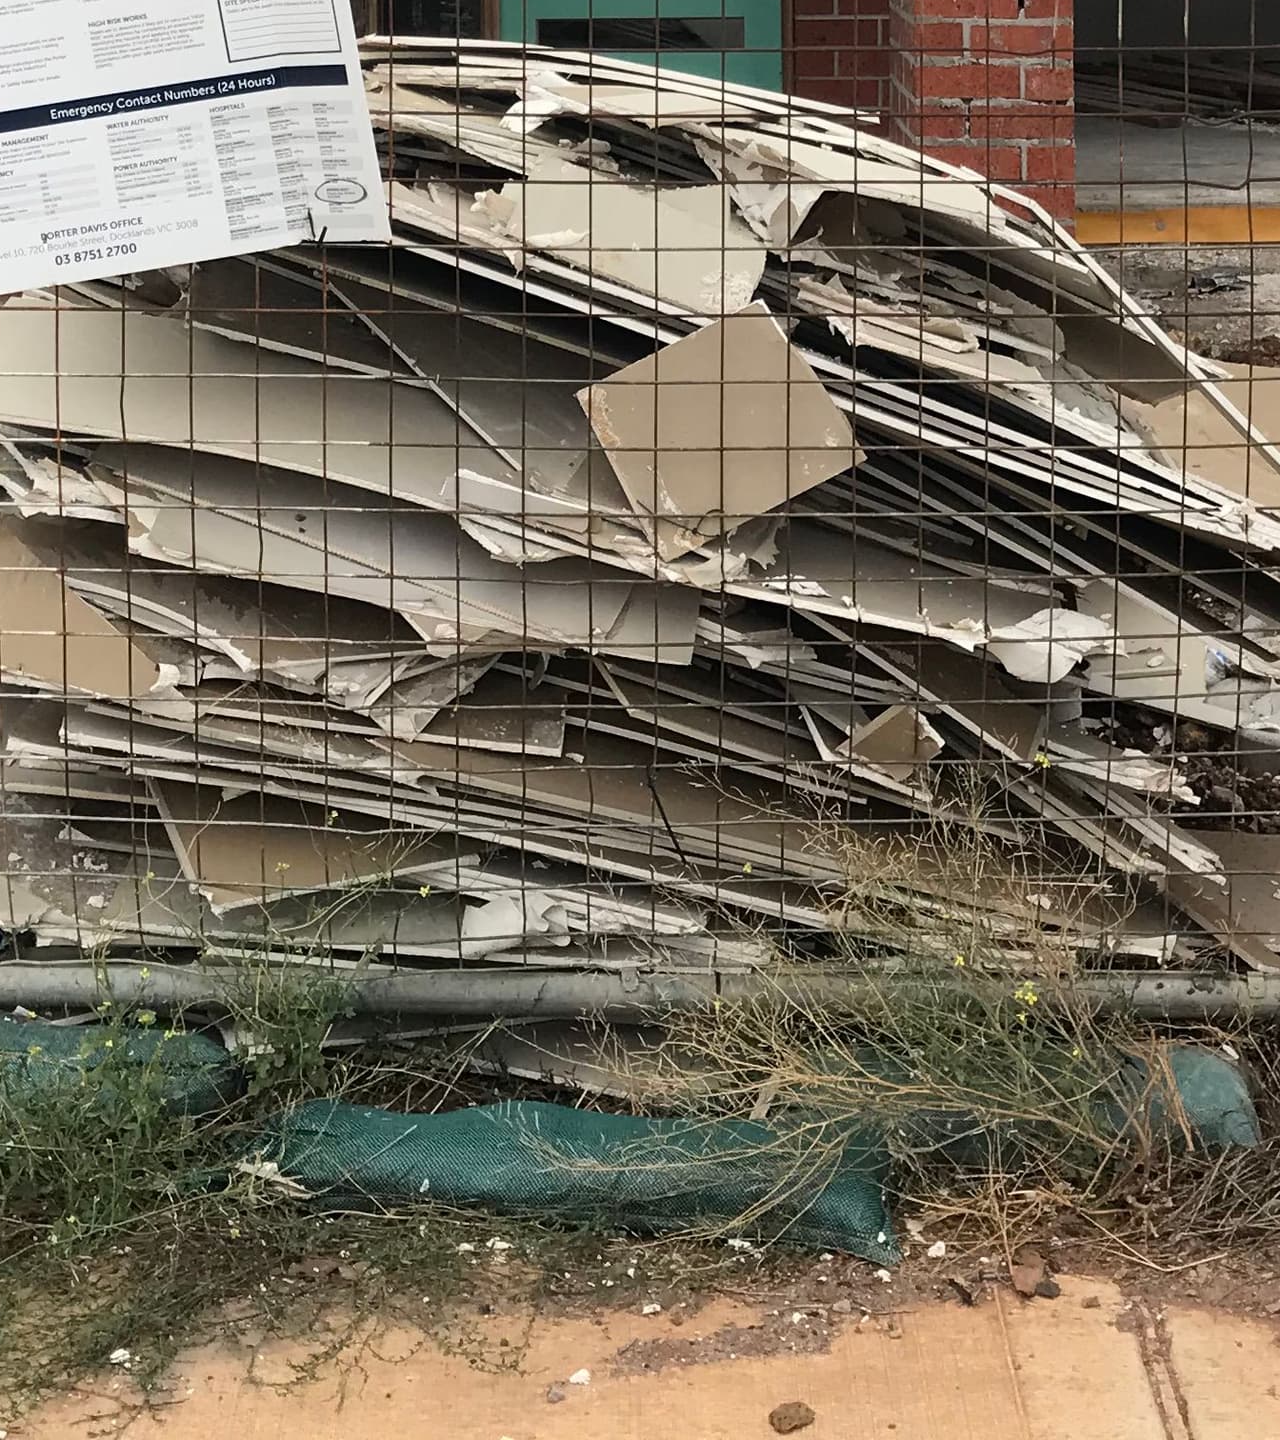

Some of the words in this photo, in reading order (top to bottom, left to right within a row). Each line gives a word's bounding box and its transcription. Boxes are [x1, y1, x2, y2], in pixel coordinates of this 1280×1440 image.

[49, 102, 114, 120] Emergency
[115, 92, 162, 109] Contact
[163, 85, 216, 101] Numbers
[217, 80, 236, 94] (24
[237, 73, 276, 90] Hours)
[208, 101, 245, 113] HOSPITALS
[105, 120, 129, 130] WATER
[129, 114, 169, 126] AUTHORITY
[0, 133, 49, 147] MANAGEMENT
[112, 162, 139, 172] POWER
[138, 155, 178, 168] AUTHORITY
[79, 222, 108, 235] DAVIS
[108, 216, 144, 230] OFFICE
[27, 244, 45, 255] 720
[46, 239, 78, 252] Bourke
[109, 225, 156, 242] Docklands
[156, 222, 173, 233] VIC
[174, 218, 199, 230] 3008
[54, 252, 71, 266] 03
[72, 247, 104, 263] 8751
[105, 242, 138, 258] 2700
